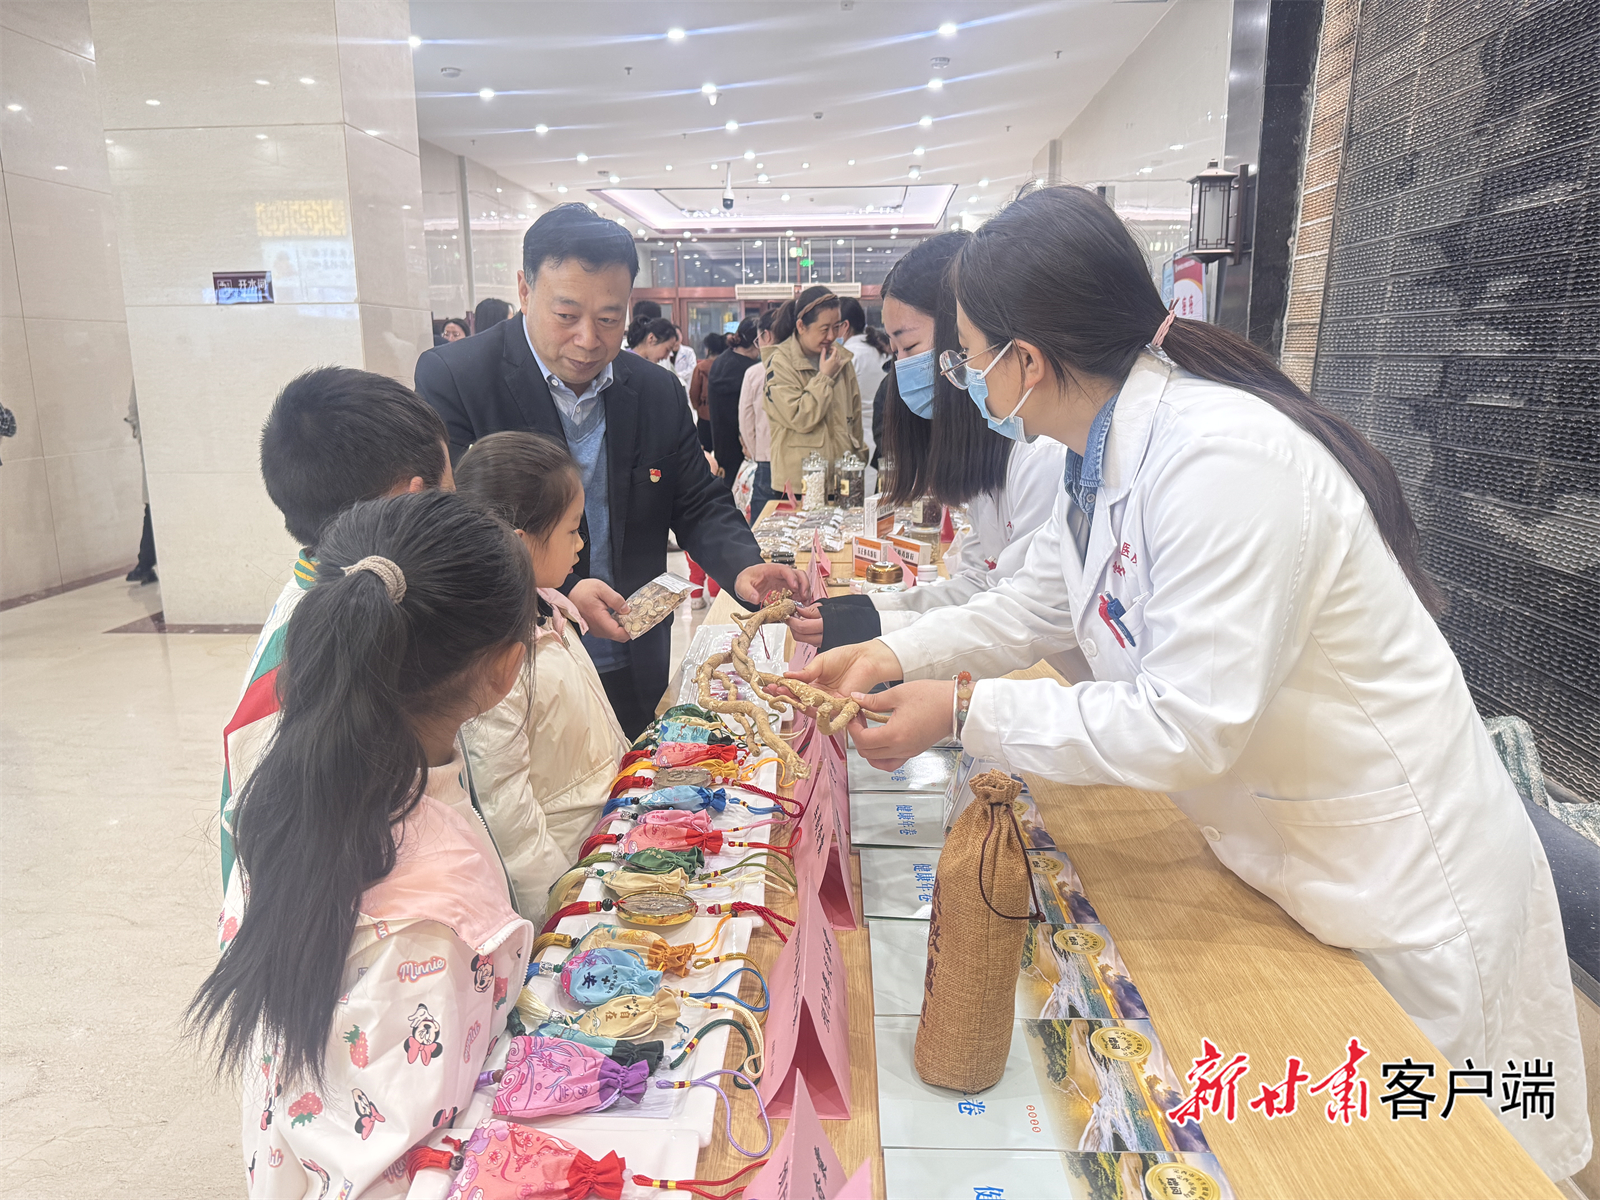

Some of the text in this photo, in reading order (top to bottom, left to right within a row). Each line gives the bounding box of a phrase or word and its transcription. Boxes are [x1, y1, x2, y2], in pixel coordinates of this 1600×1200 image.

[896, 804, 917, 835] 健康年卷
[400, 957, 445, 982] Minnie
[582, 972, 598, 989] 安
[605, 1011, 630, 1022] 自在
[1166, 1177, 1182, 1195] 赠阅
